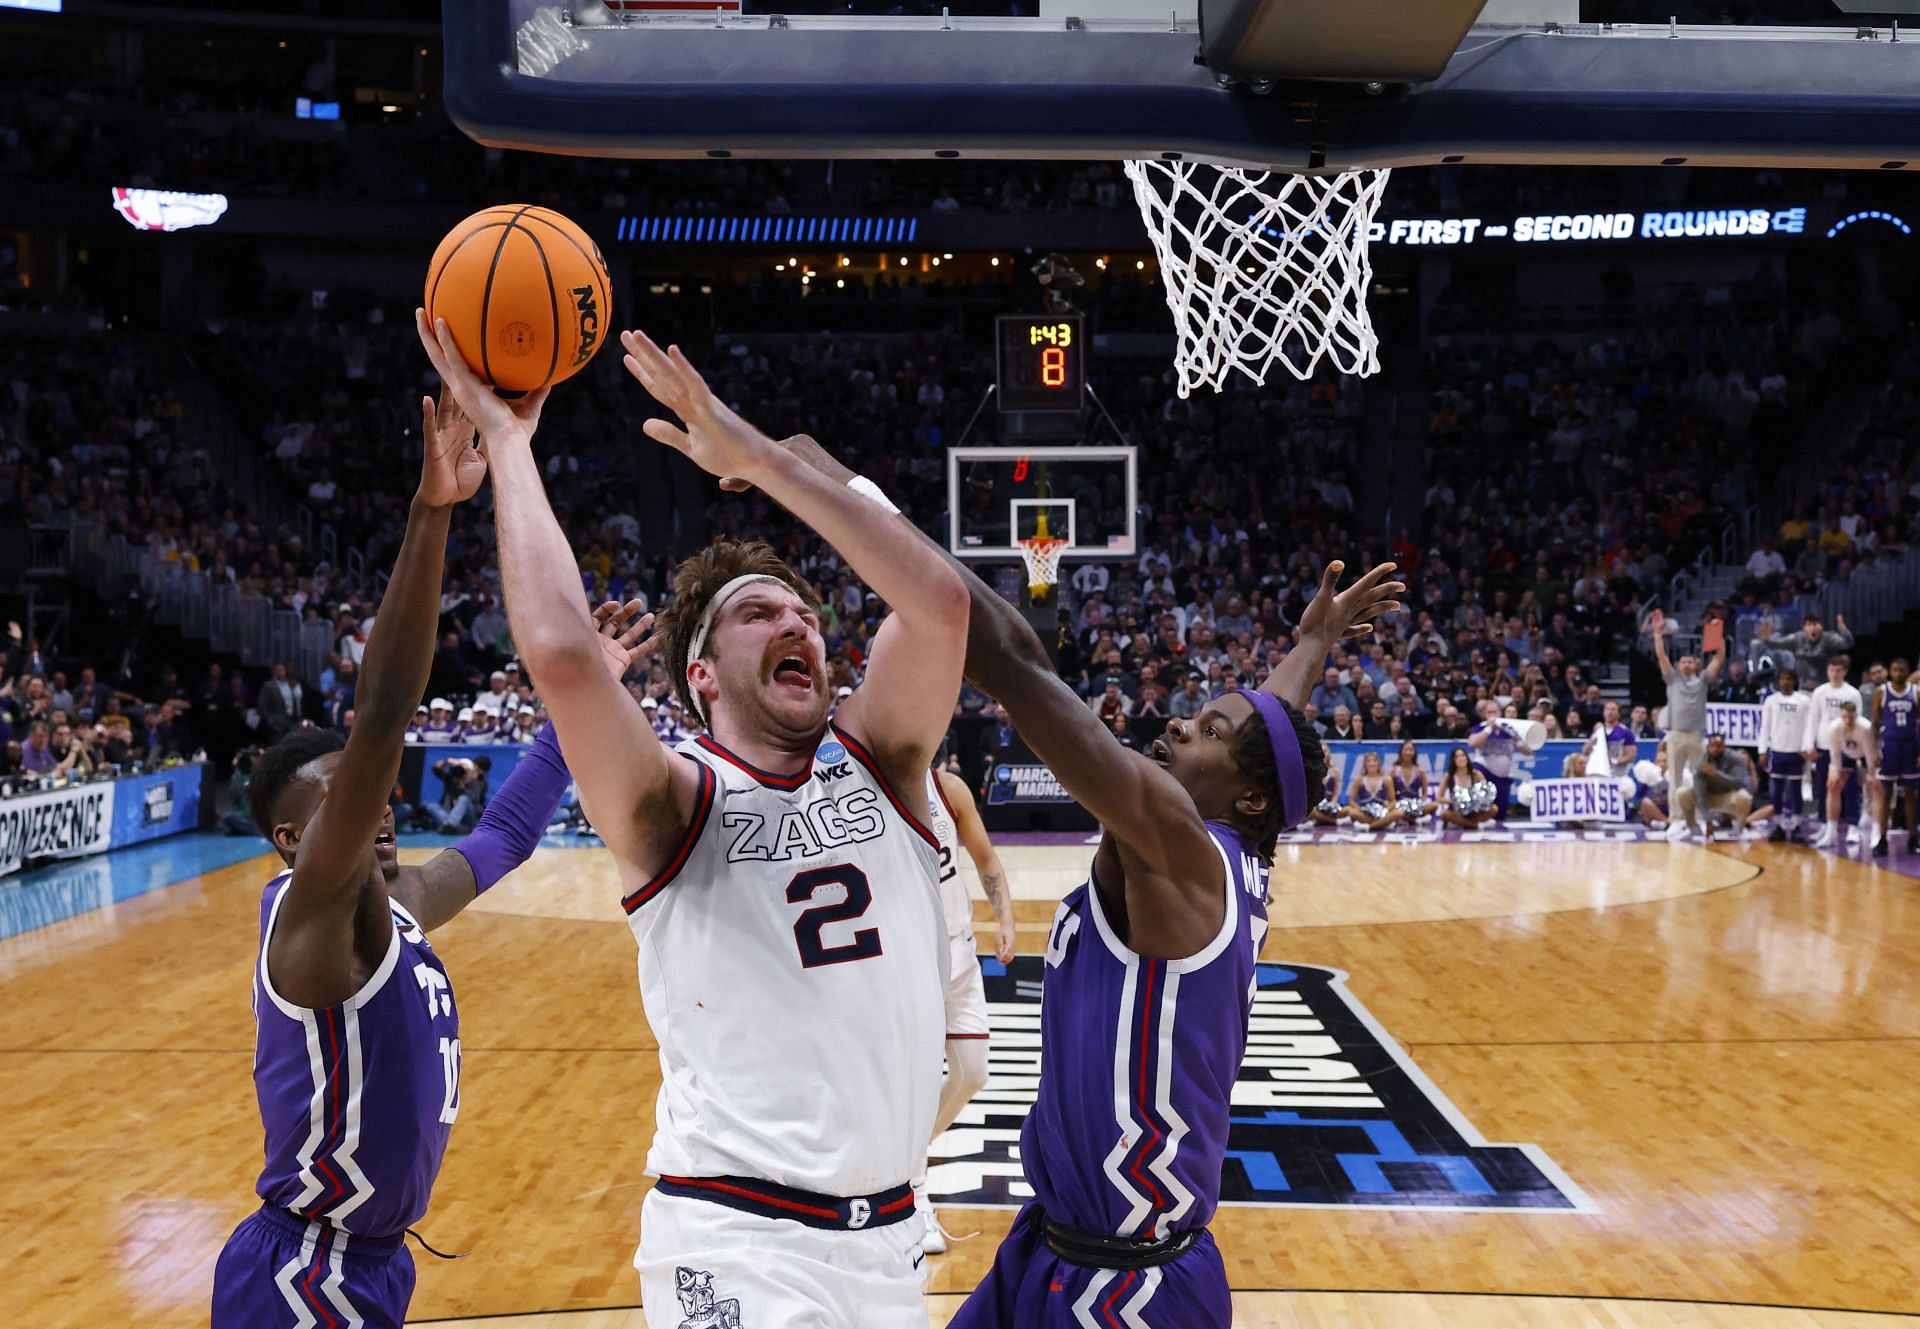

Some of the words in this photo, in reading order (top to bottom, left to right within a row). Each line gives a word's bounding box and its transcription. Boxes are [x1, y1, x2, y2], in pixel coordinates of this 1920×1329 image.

[1389, 218, 1481, 244] FIRST
[1513, 213, 1635, 242] SECOND
[1641, 208, 1770, 238] ROUNDS
[572, 284, 598, 367] NCAA
[1030, 323, 1071, 347] 1:43
[1042, 347, 1065, 386] 8
[1535, 782, 1620, 816] DEFENSE
[0, 793, 104, 865] CONFERENCE
[722, 787, 886, 864] ZAGS
[786, 862, 884, 969] 2
[847, 1198, 872, 1229] G
